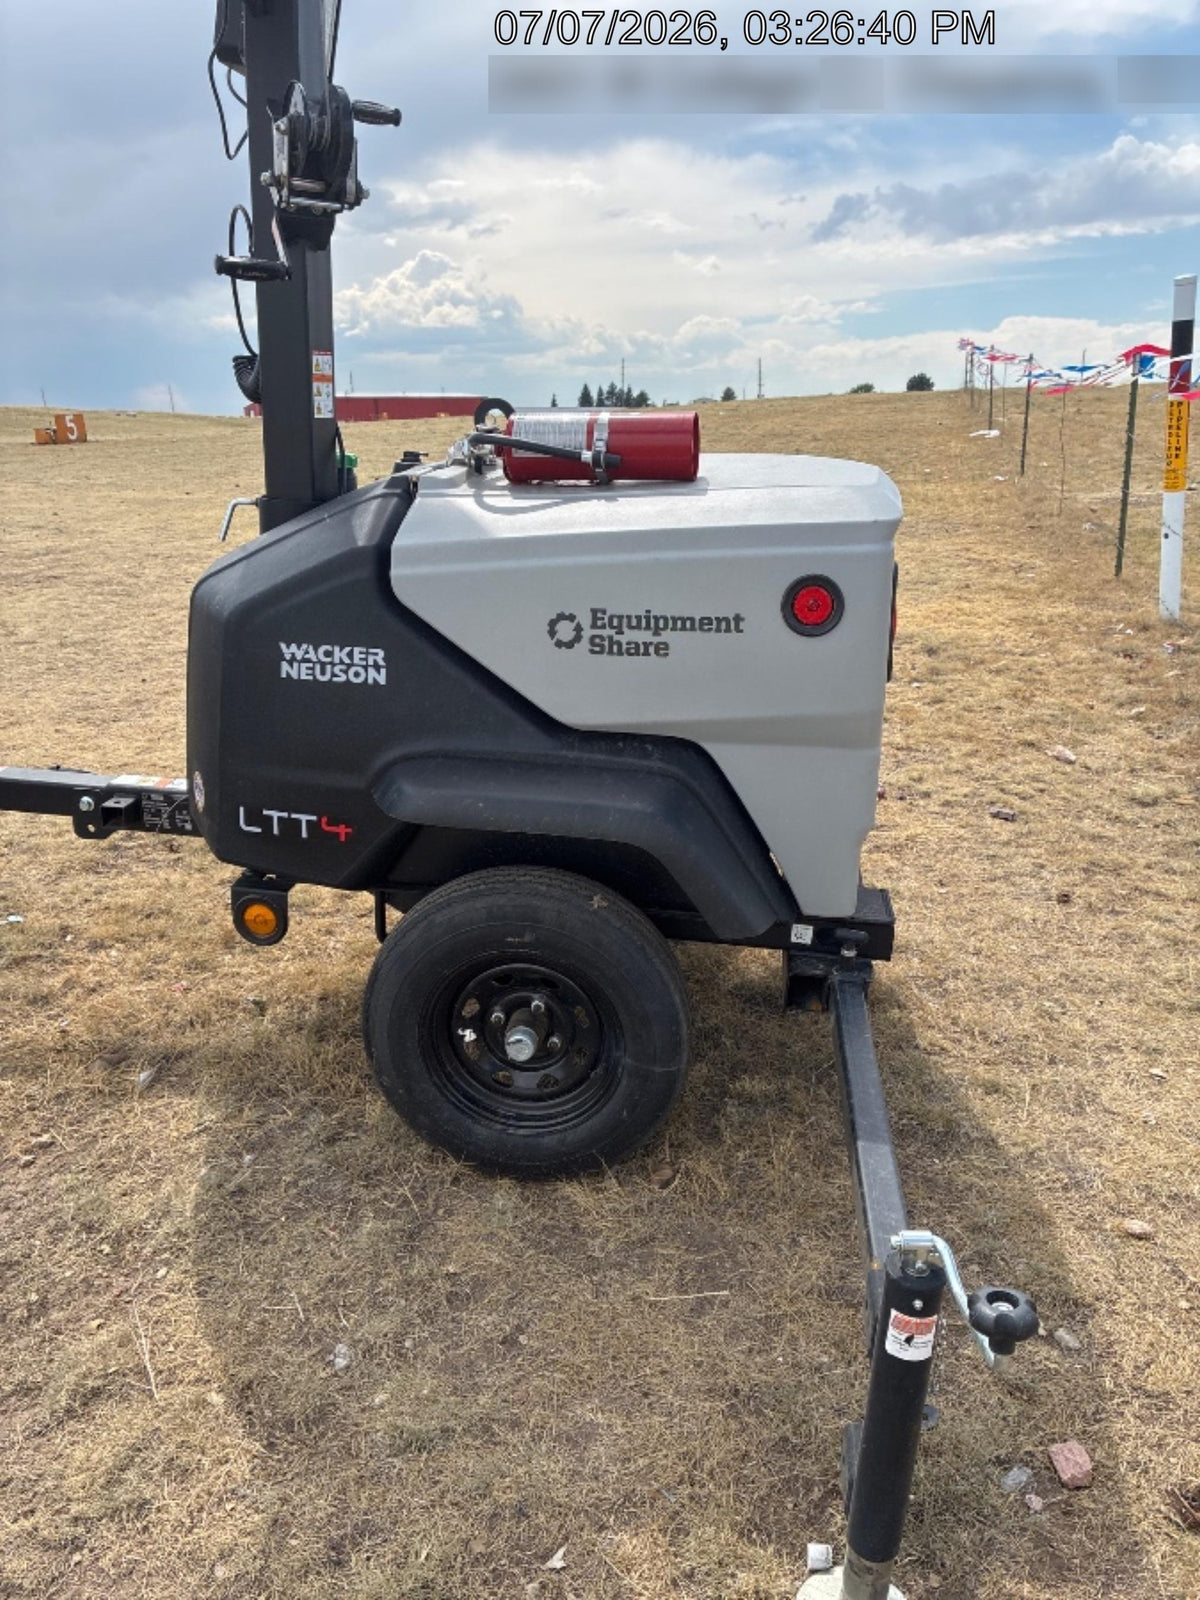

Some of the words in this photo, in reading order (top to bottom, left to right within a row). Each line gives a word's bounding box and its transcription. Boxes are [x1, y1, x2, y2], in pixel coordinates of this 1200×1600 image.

[65, 415, 78, 440] 5
[588, 608, 745, 636] Equipment
[279, 641, 386, 666] WACKER
[588, 635, 670, 658] Share
[280, 661, 387, 685] NEUSON
[239, 806, 352, 842] LTT4
